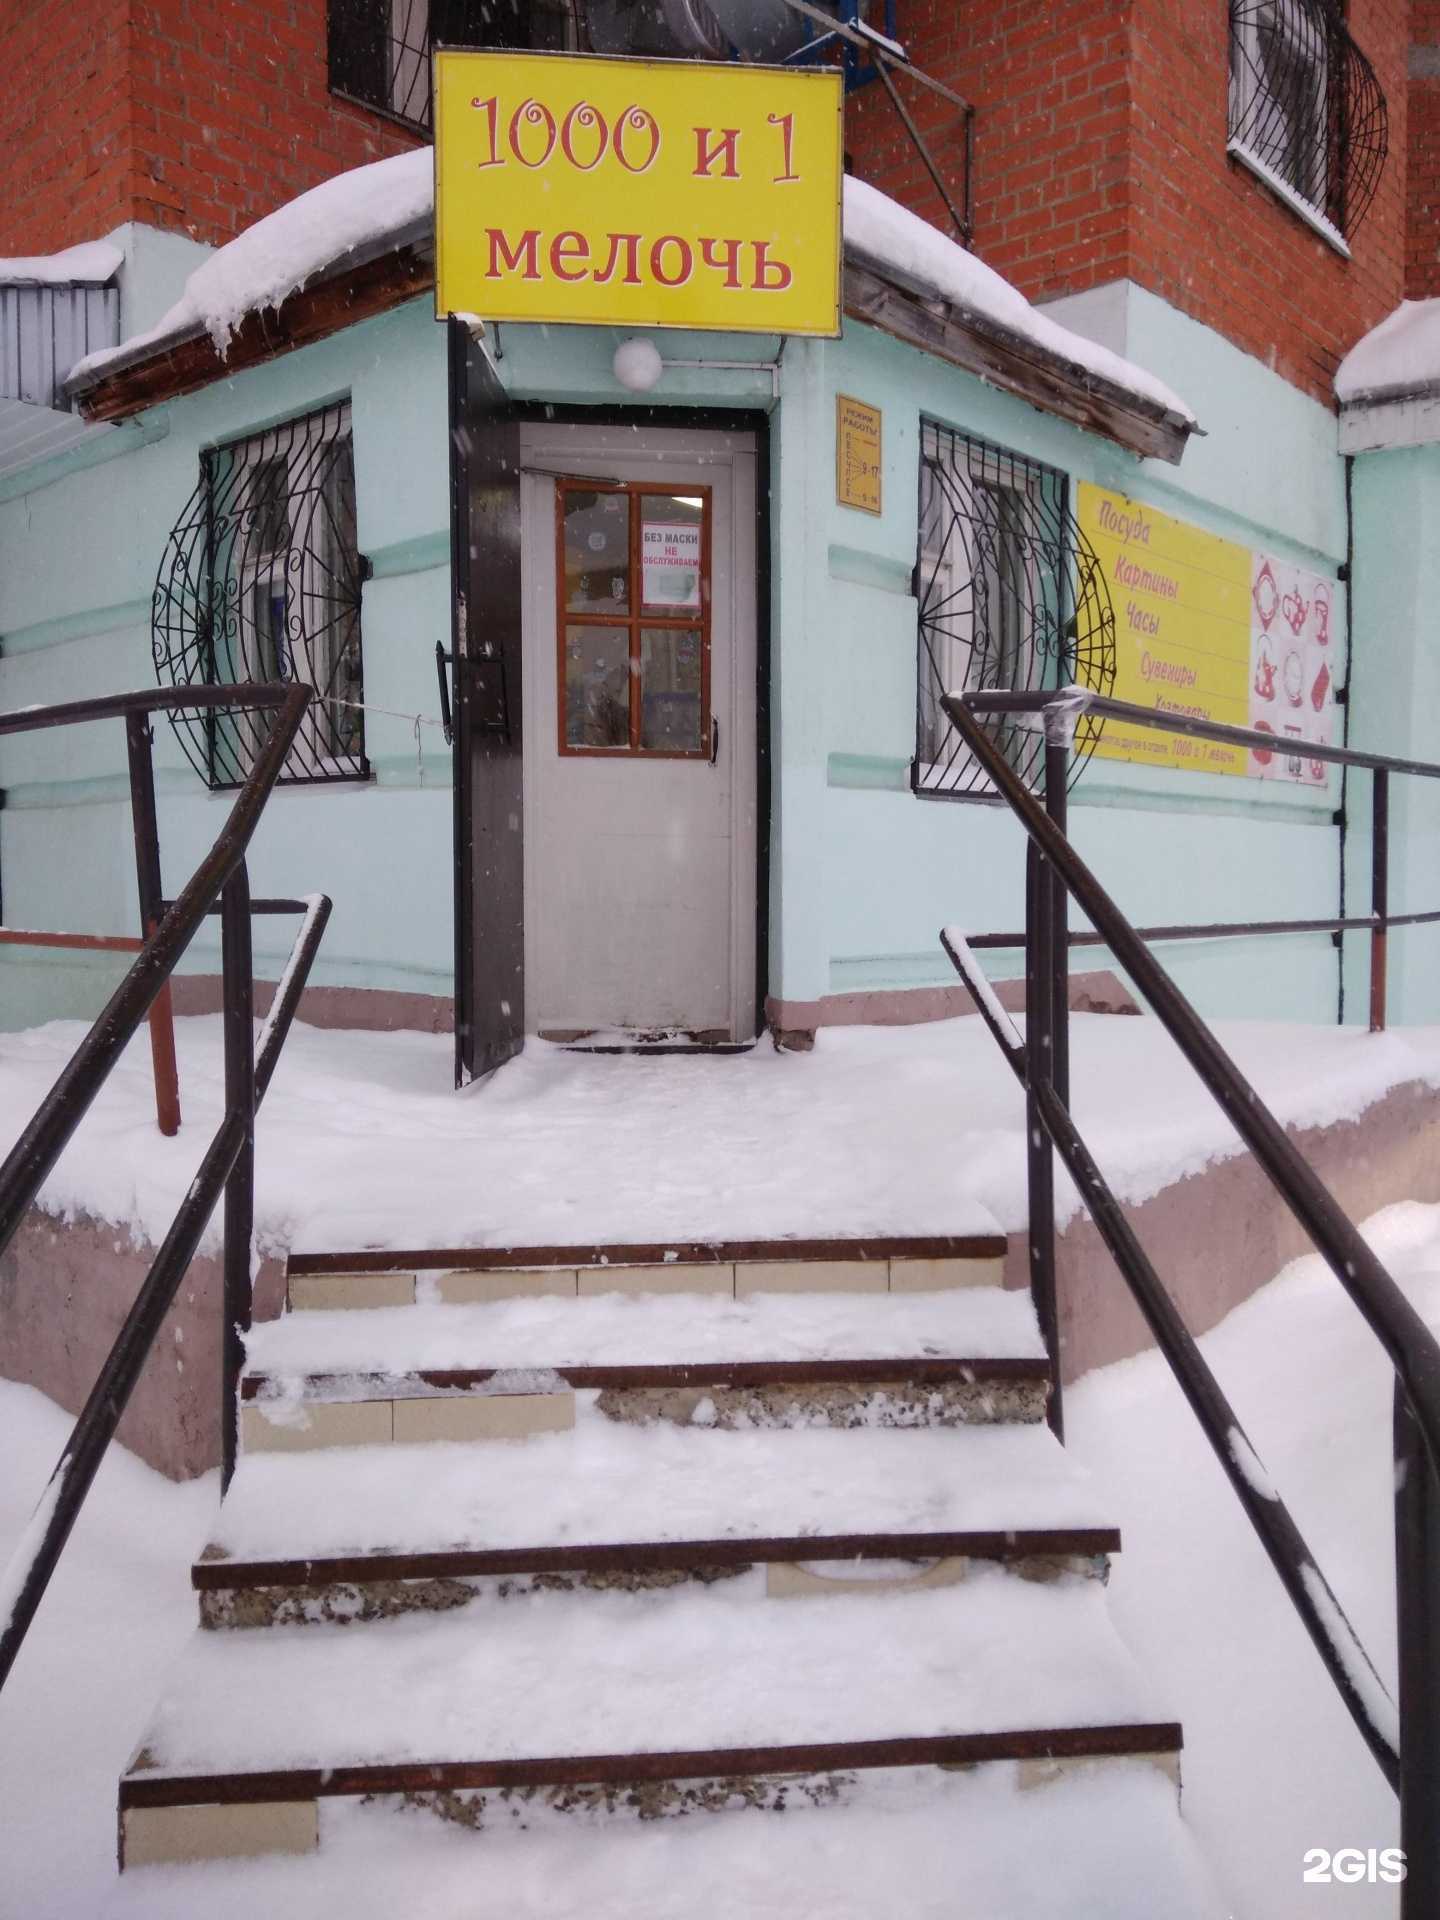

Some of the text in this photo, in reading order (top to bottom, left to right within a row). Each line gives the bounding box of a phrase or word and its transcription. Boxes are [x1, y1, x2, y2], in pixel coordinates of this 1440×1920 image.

[471, 96, 801, 184] 1000 и 1
[484, 227, 794, 292] мелочь
[644, 532, 698, 545] БЕЗ МАСКИ
[1098, 500, 1151, 545] Посуда
[664, 546, 678, 556] НЕ
[1113, 555, 1179, 599] Картины
[1126, 600, 1160, 635] Часы
[1140, 651, 1197, 688] Сувениры
